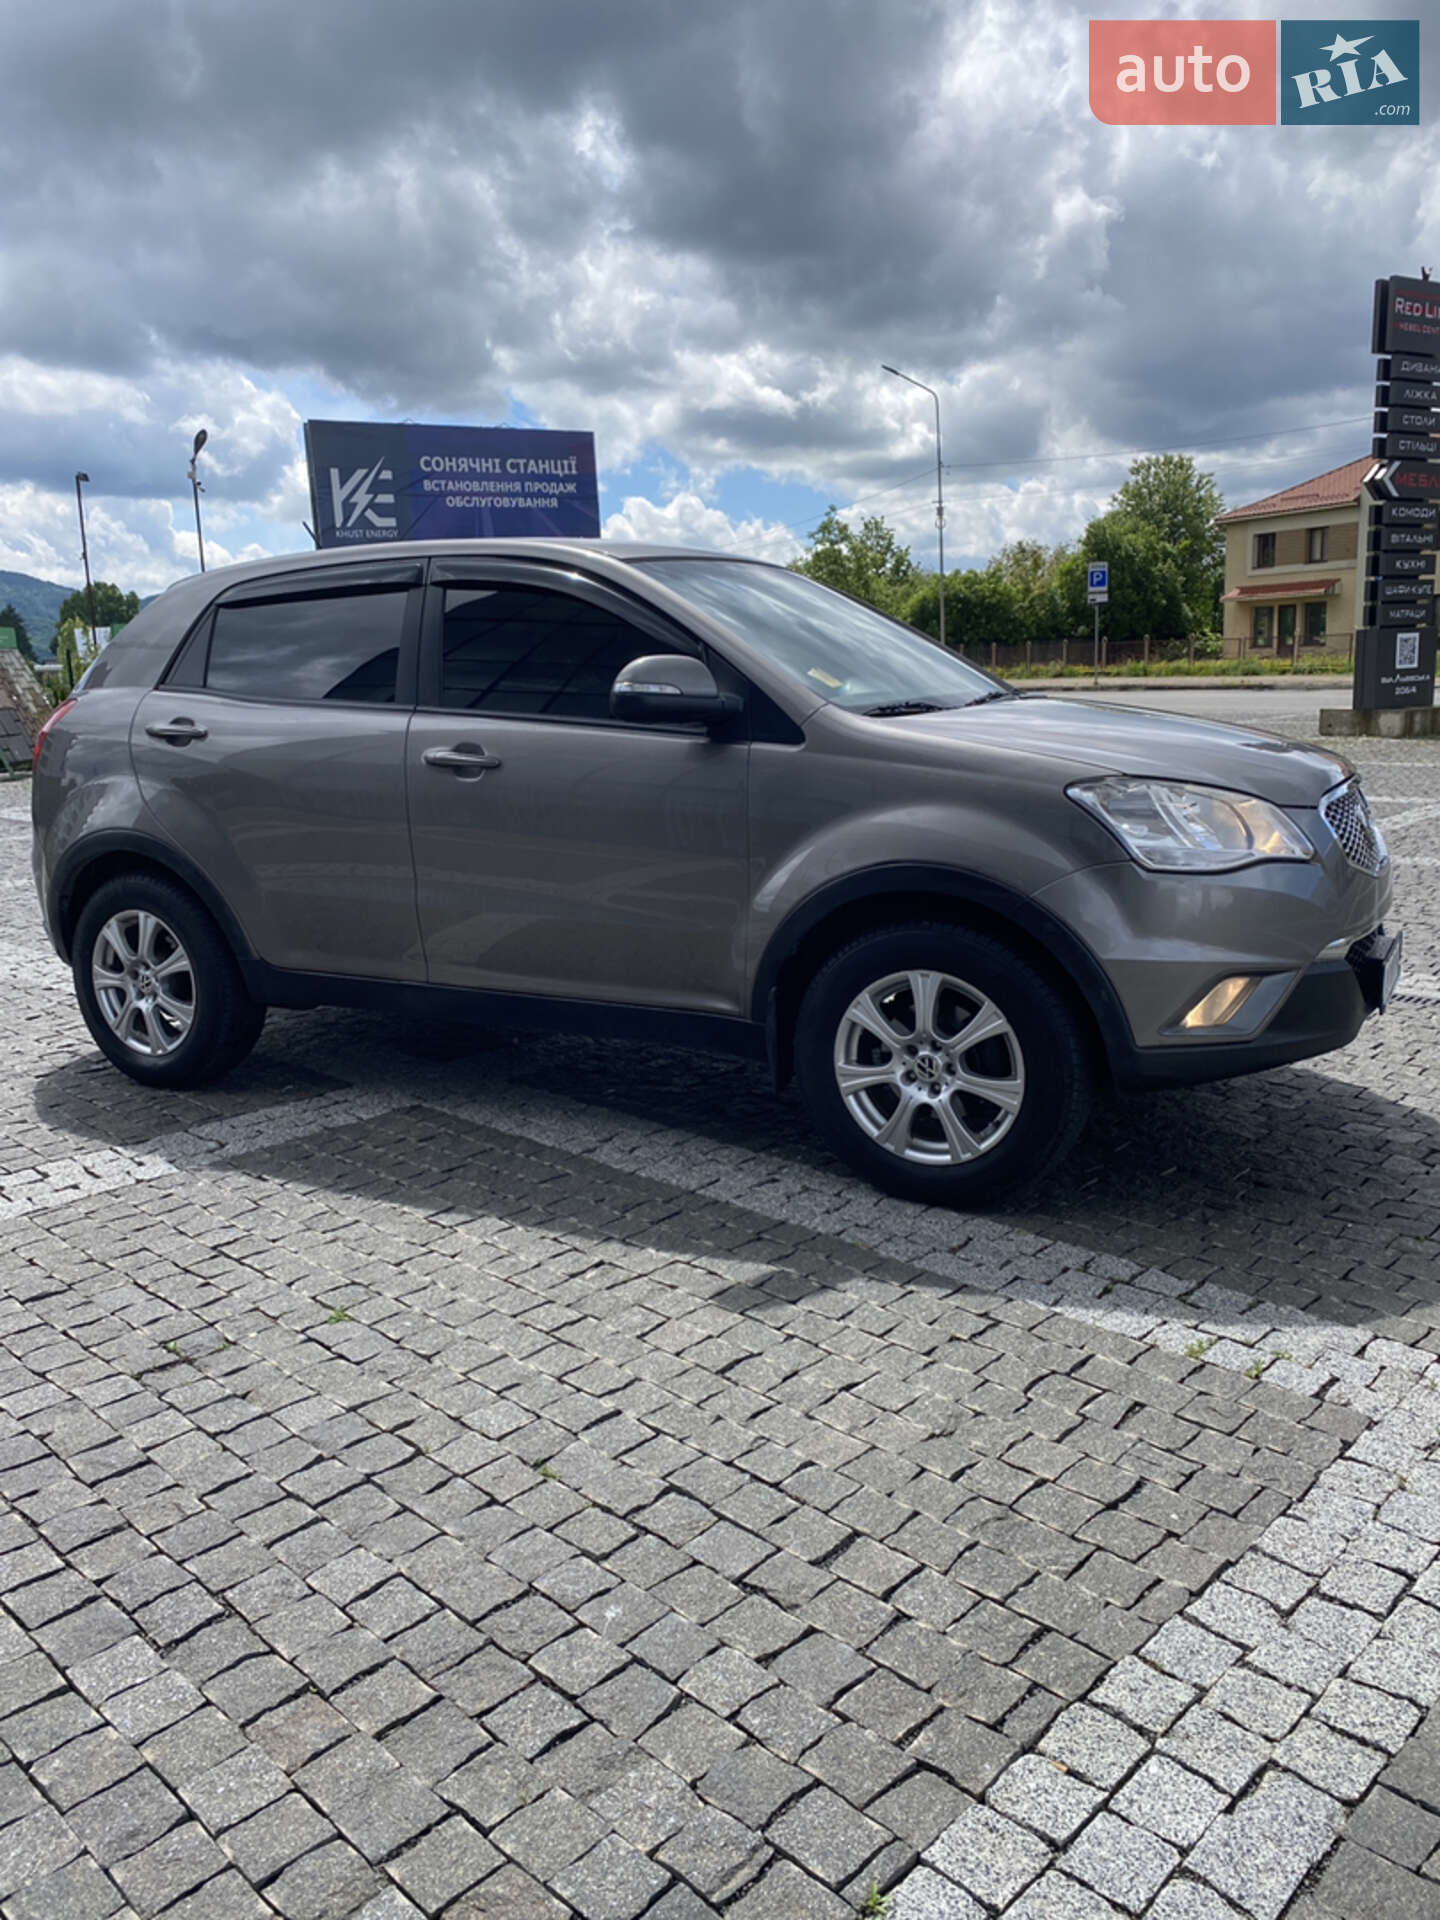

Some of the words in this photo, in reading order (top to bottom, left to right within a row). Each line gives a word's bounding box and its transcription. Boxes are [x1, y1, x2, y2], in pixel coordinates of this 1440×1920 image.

[1404, 389, 1437, 400] ЛІЖКА
[1403, 414, 1436, 425] СТОЛИ
[1399, 440, 1437, 453] СТІЛЬЦІ
[419, 456, 502, 474] СОНЯЧНІ
[506, 456, 578, 477] СТАНЦІЇ
[423, 479, 522, 493] ВСТАНОВЛЕННЯ
[525, 481, 577, 495] ПРОДАЖ
[446, 495, 559, 508] ОБСЛУГОВУВАННЯ
[1391, 507, 1436, 518] КОМОДИ
[365, 529, 399, 538] ENERGY
